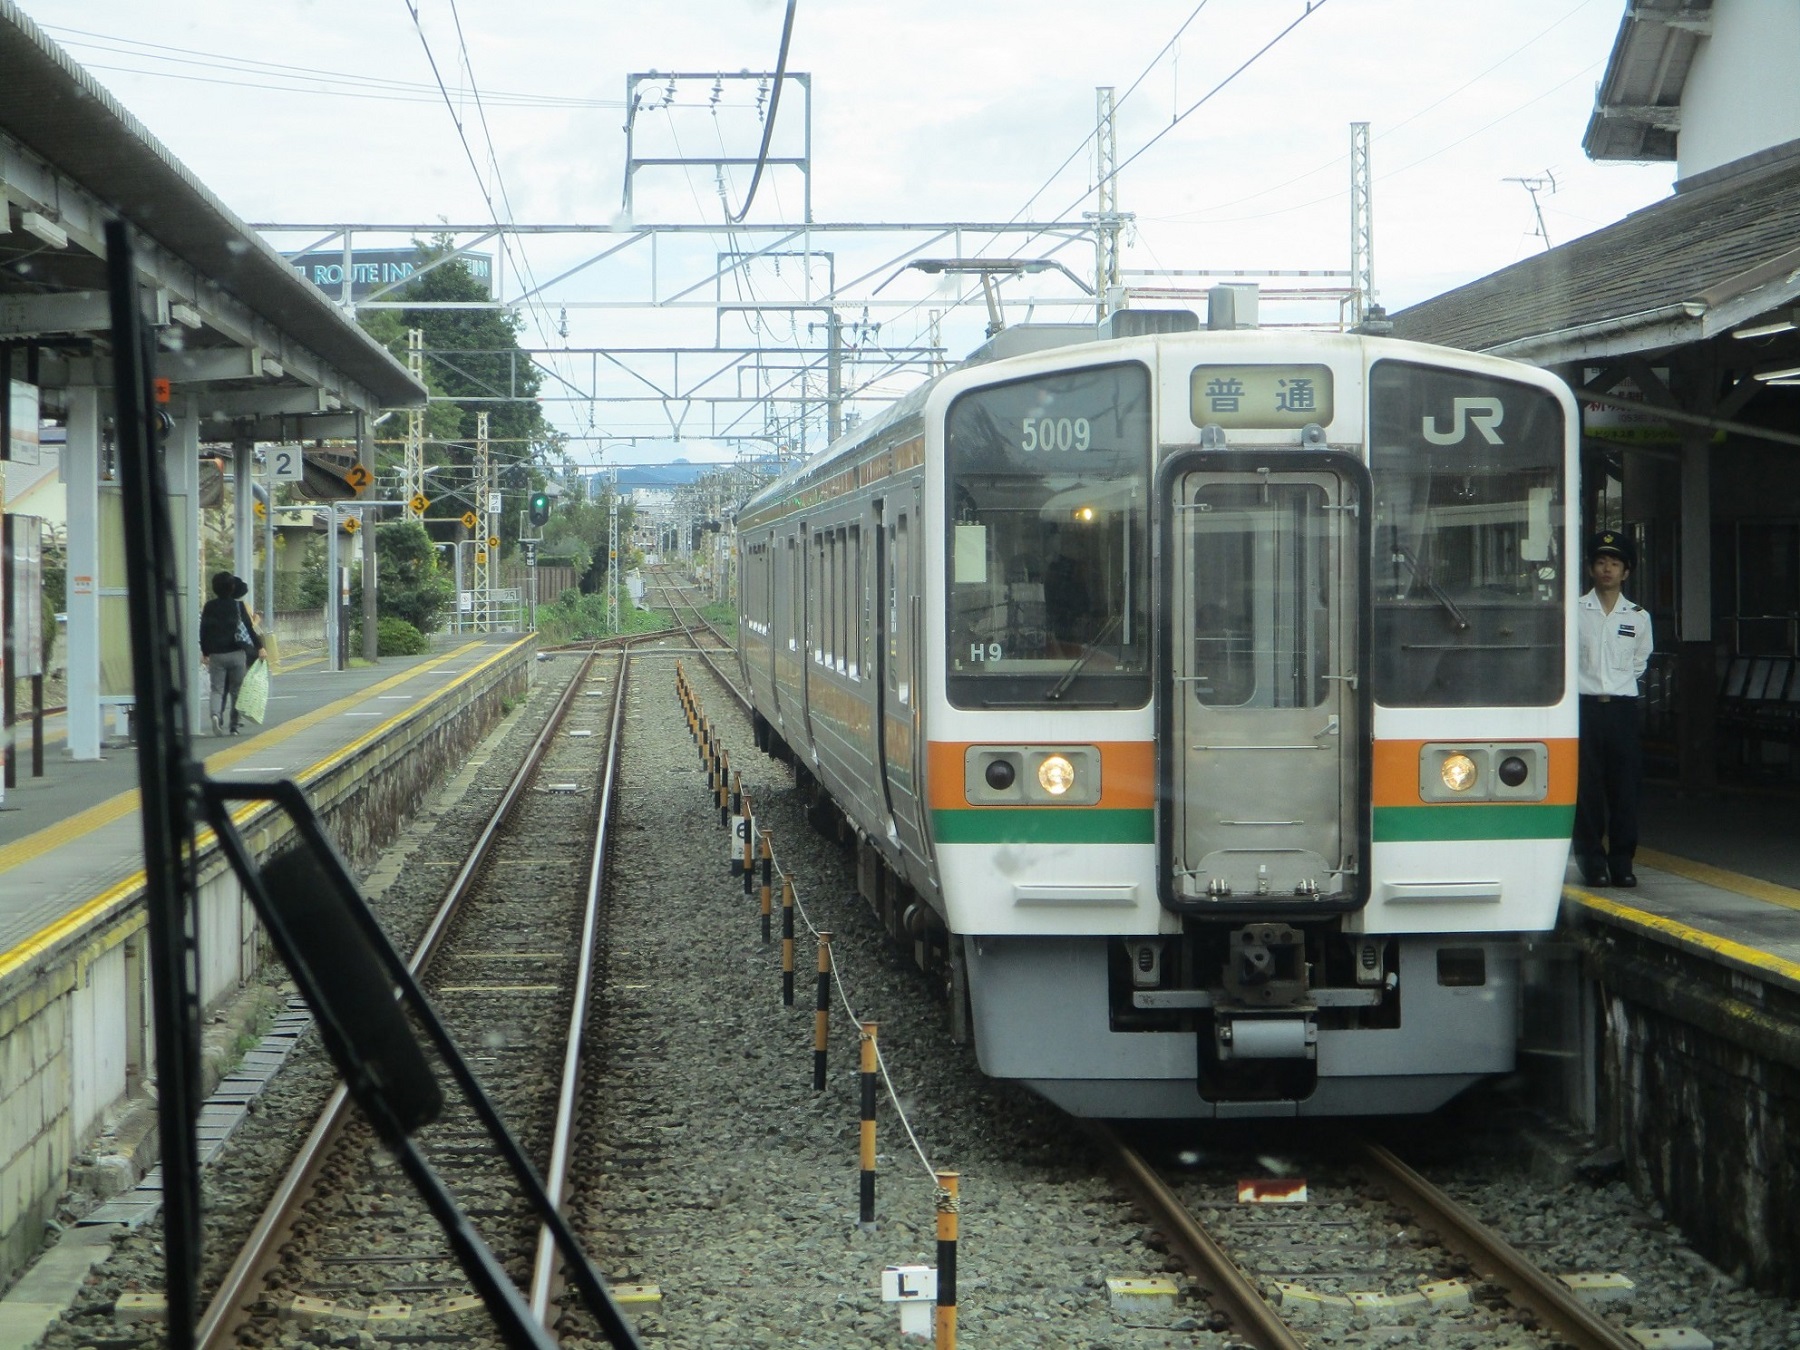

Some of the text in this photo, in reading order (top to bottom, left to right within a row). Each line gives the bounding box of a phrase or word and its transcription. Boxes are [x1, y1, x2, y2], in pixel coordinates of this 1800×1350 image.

[314, 263, 379, 285] ROUTE
[1205, 377, 1317, 413] 普通
[1422, 397, 1505, 446] JR
[1021, 417, 1091, 452] 5009
[275, 453, 292, 475] 2
[351, 468, 367, 487] 2
[413, 497, 425, 511] 3
[346, 518, 356, 530] 4
[464, 514, 474, 525] 4
[970, 643, 1002, 662] H9
[898, 1273, 919, 1297] L
